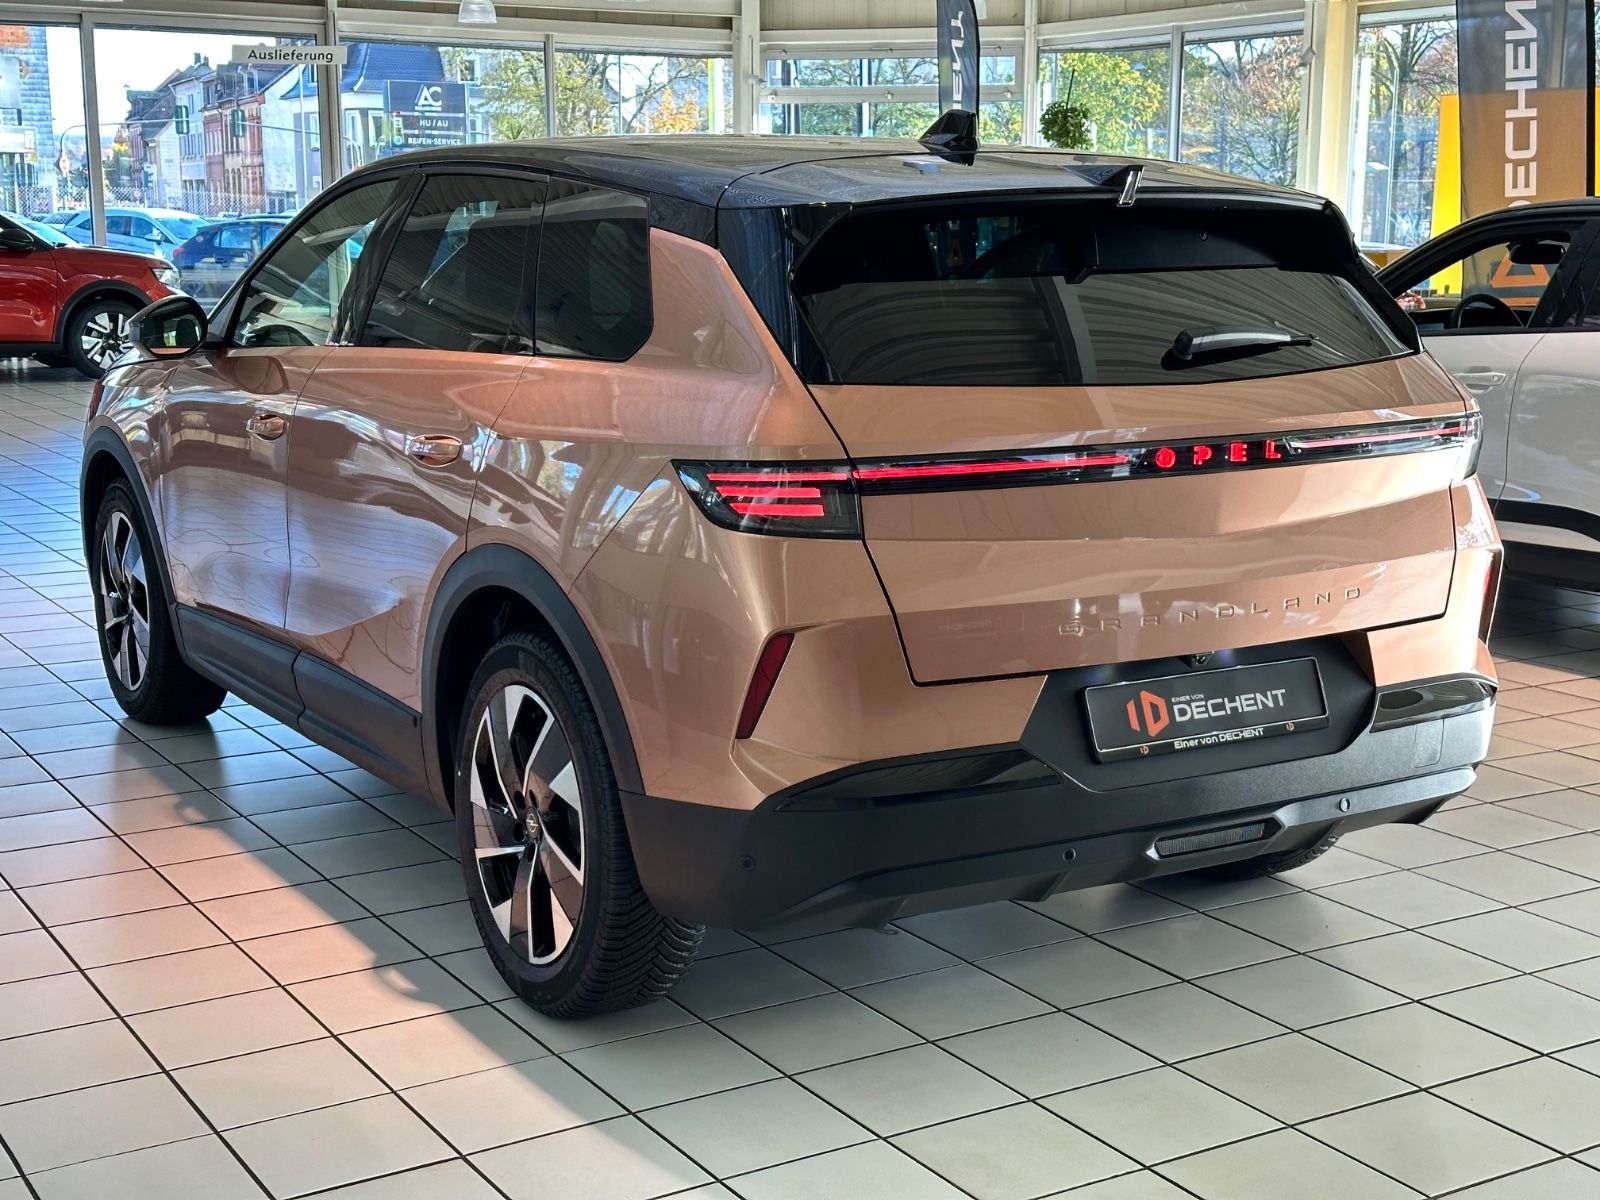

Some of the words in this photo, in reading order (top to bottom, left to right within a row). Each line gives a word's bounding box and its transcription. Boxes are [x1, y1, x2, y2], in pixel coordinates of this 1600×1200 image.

[247, 49, 334, 63] Auslieferung
[415, 83, 442, 106] AC
[419, 119, 431, 127] HU
[437, 119, 449, 128] AU
[407, 137, 462, 145] REIFEN-SERVICE
[1155, 439, 1282, 469] OPEL
[1058, 586, 1361, 637] GRANDLAND
[1172, 688, 1286, 723] DECHENT
[1173, 739, 1200, 750] Einer
[1199, 735, 1219, 746] von
[1219, 727, 1264, 742] DECHENT
